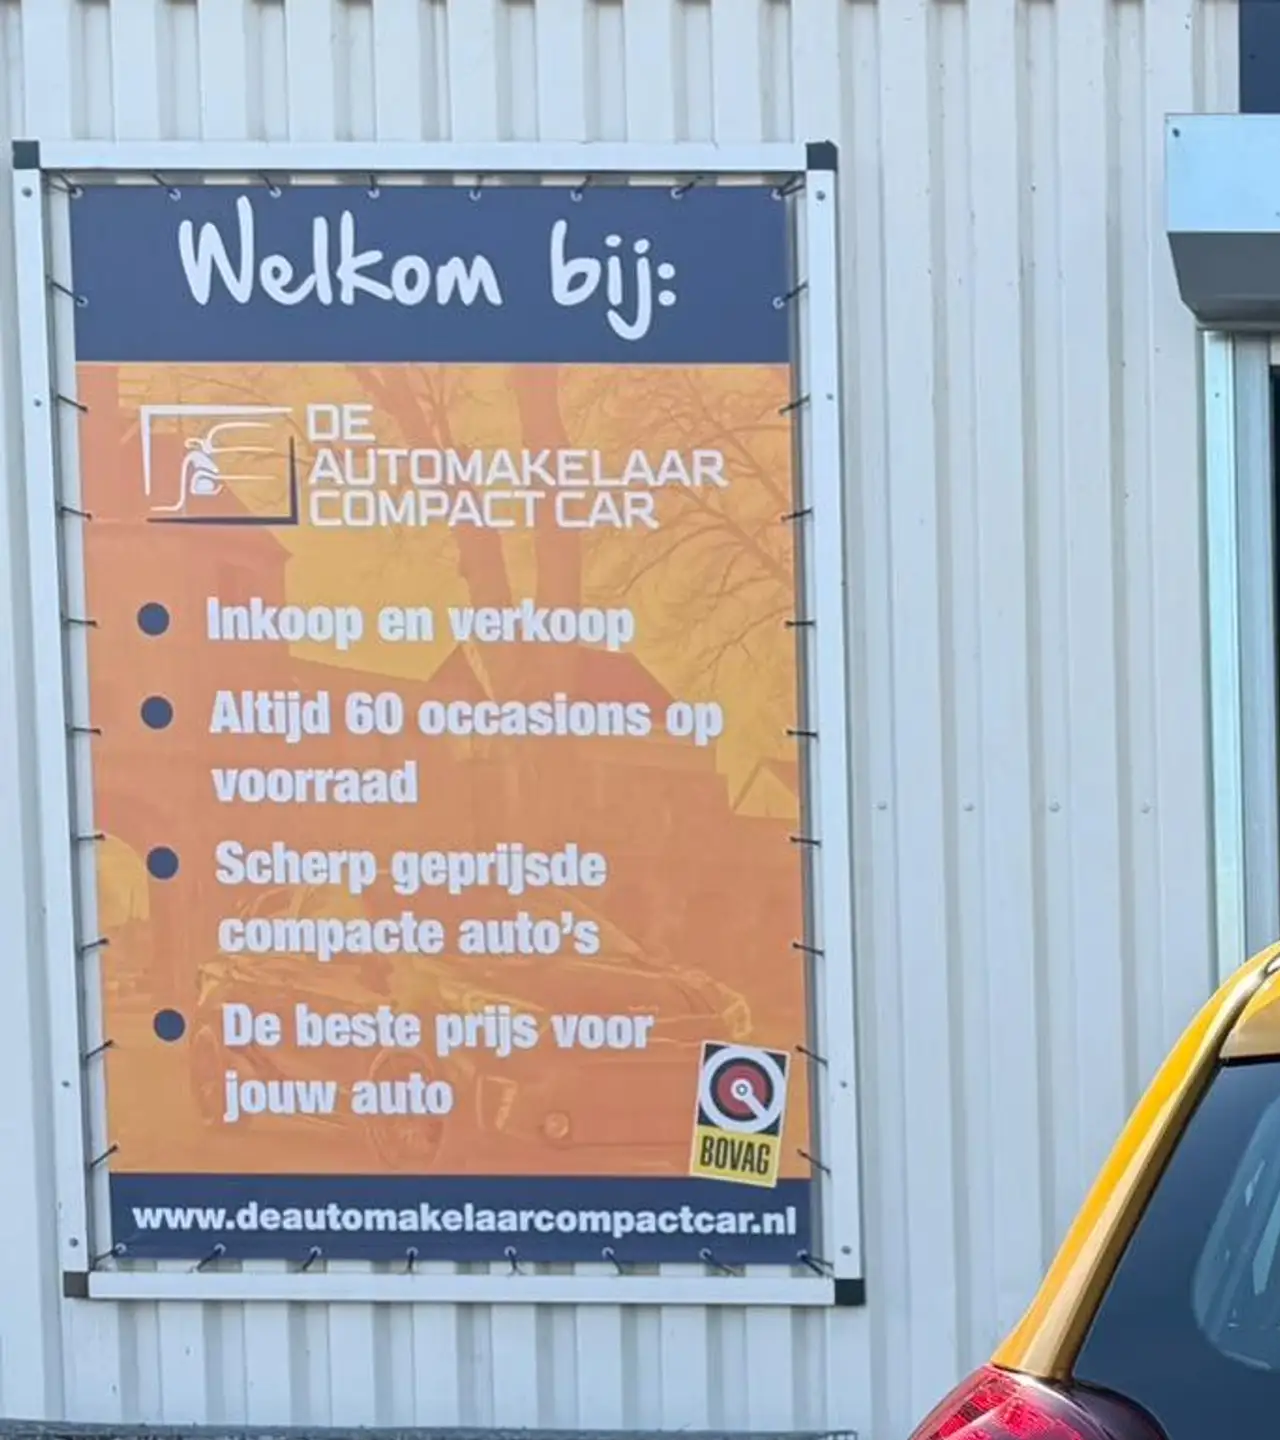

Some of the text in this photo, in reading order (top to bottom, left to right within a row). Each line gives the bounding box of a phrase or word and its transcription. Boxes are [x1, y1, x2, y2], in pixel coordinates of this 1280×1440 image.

[178, 195, 676, 340] Welkom bij:
[306, 403, 376, 443] DE
[308, 446, 729, 490] AUTOMAKELAAR
[307, 489, 660, 532] COMPACT CAR
[206, 596, 636, 653] Inkoop en verkoop
[208, 689, 725, 747] Altijd 60 occasions op
[210, 759, 419, 805] voorraad
[214, 840, 607, 896] Scherp geprijsde
[218, 910, 601, 963] compacte auto's
[221, 1002, 656, 1058] De beste prijs voor
[223, 1069, 454, 1123] jouw auto
[700, 1134, 771, 1176] BOVAG
[132, 1201, 796, 1238] www.deautomakelaarcompactcar.nl
